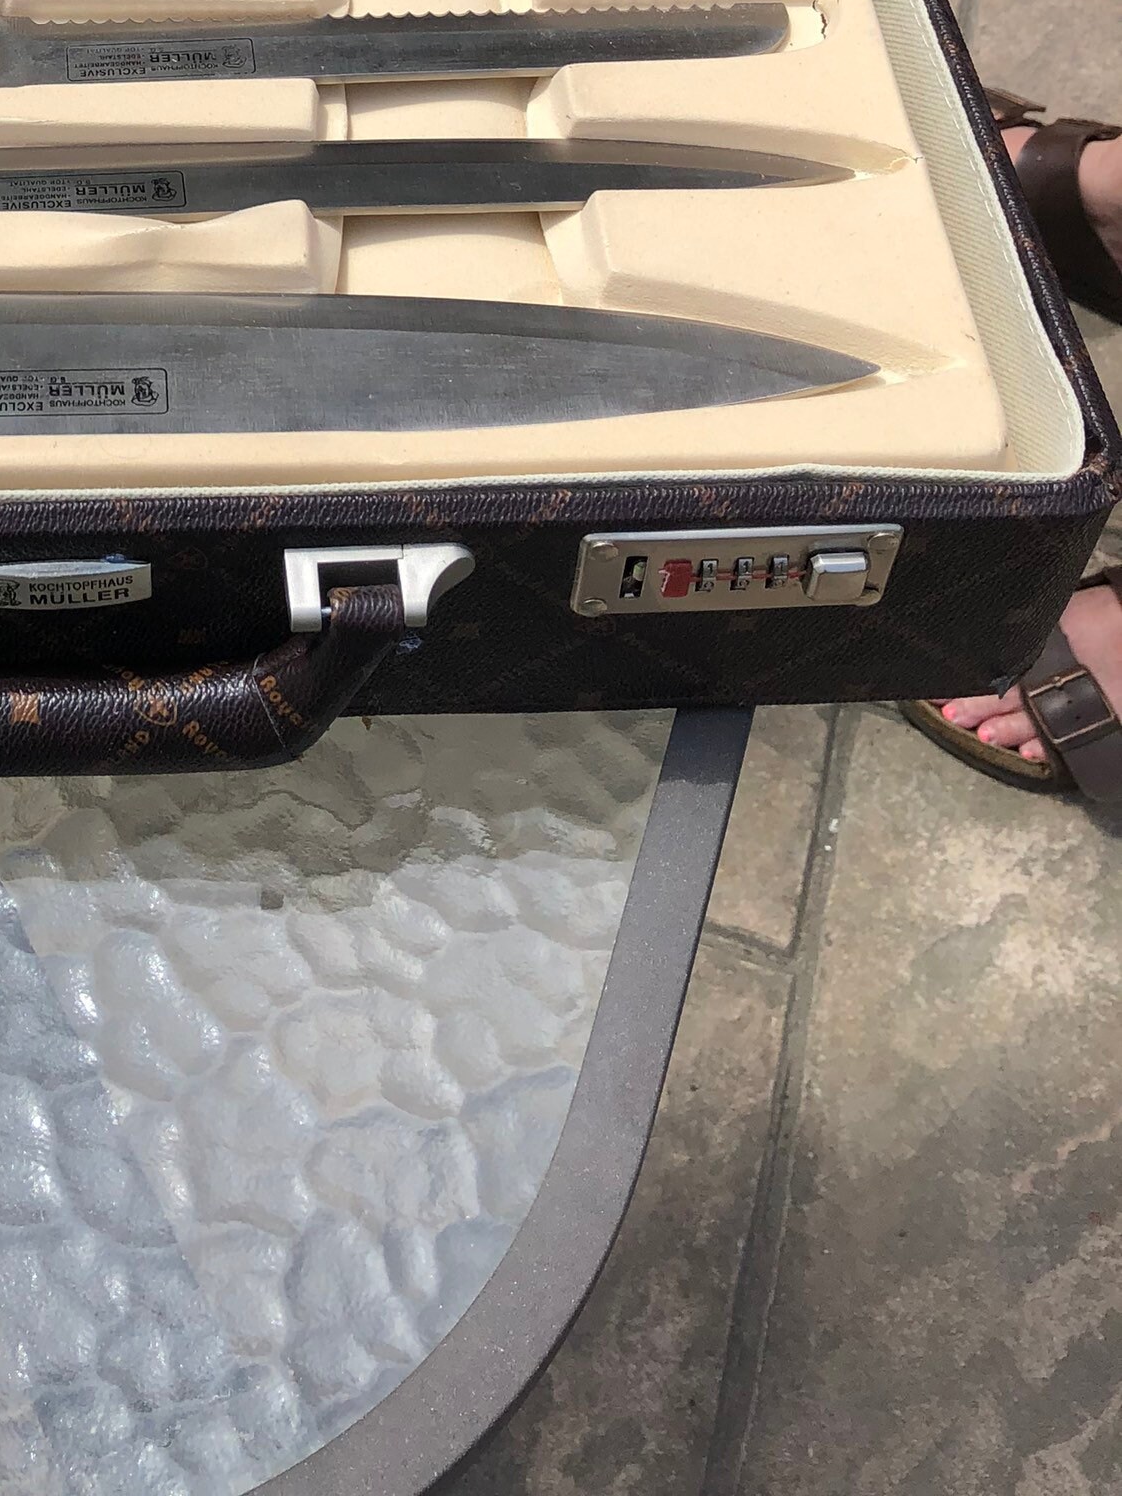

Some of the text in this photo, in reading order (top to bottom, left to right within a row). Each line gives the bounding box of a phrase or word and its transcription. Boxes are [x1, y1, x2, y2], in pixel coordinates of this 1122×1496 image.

[149, 52, 216, 64] MÜLLER
[79, 67, 146, 78] EXCLUSIVE
[75, 185, 146, 197] MÜLLER
[1, 199, 72, 210] EXCLUSIVE
[47, 385, 125, 399] MÜLLER
[29, 575, 134, 592] KOCHTOPFHAUS
[30, 587, 130, 605] MÜLLER
